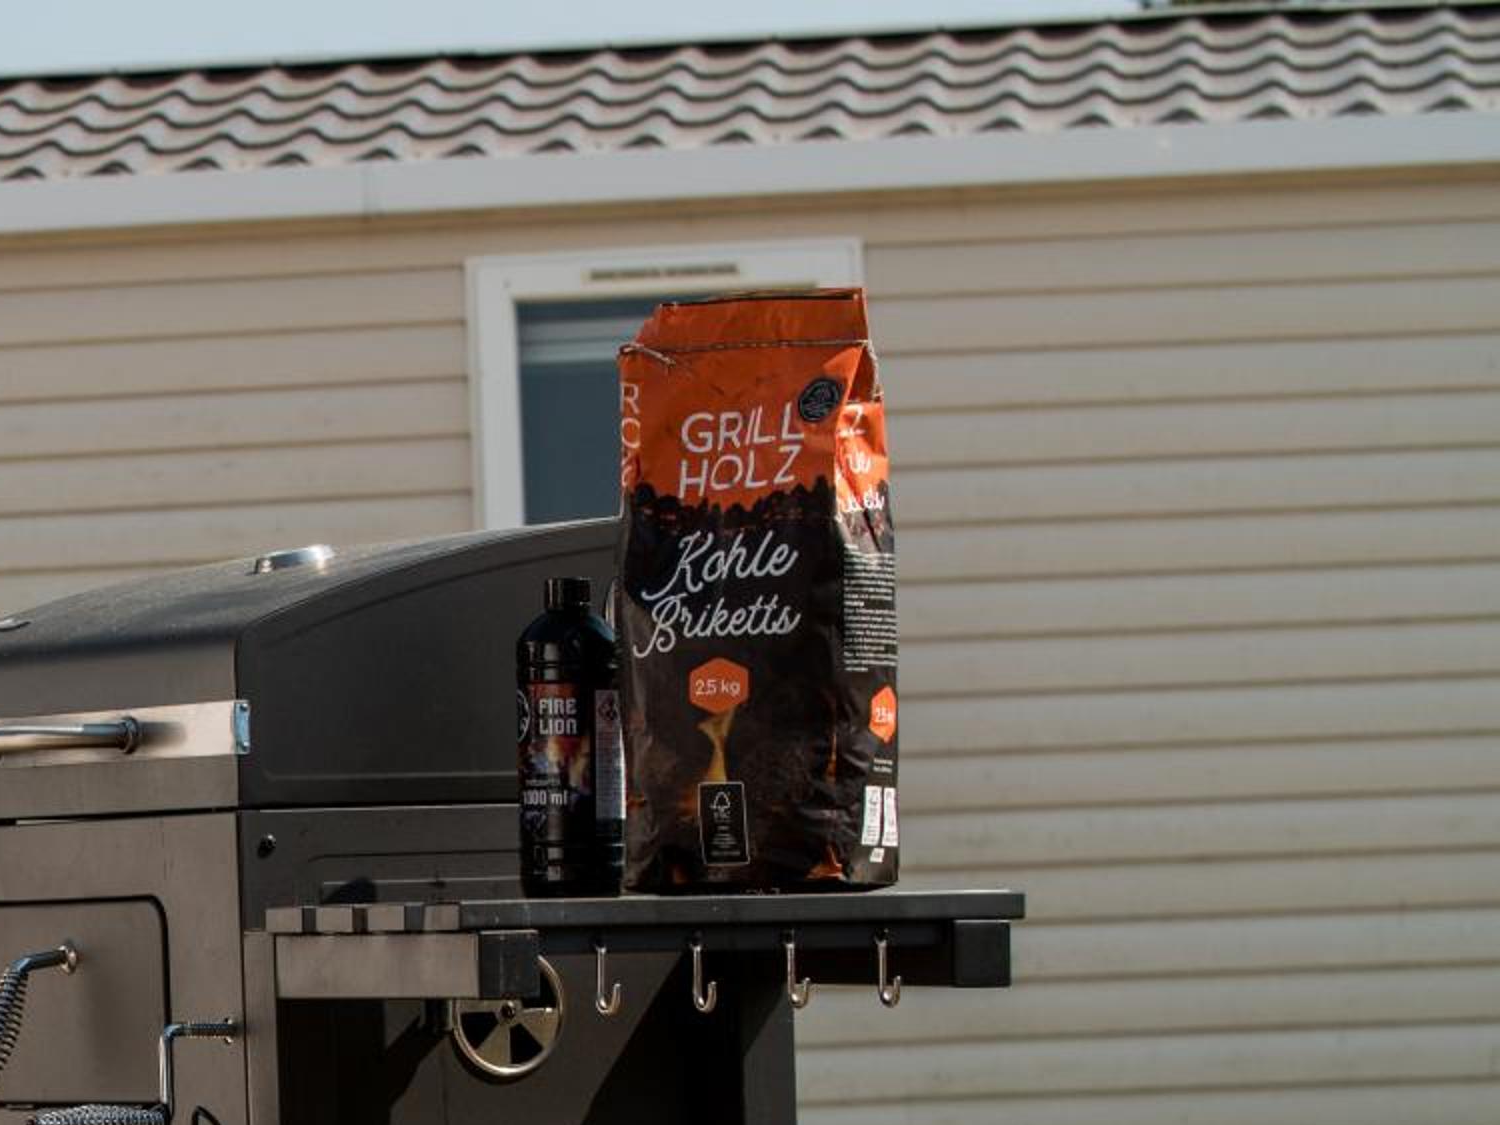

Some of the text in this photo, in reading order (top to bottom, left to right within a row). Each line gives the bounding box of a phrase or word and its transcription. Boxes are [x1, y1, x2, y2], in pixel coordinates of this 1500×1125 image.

[681, 401, 805, 453] GRILL
[678, 444, 802, 499] HOLZ
[641, 529, 799, 601] Kohle
[632, 592, 801, 659] Briketts
[539, 697, 577, 715] FIRE
[721, 678, 741, 698] kg
[539, 717, 577, 736] LION
[551, 789, 569, 806] ml
